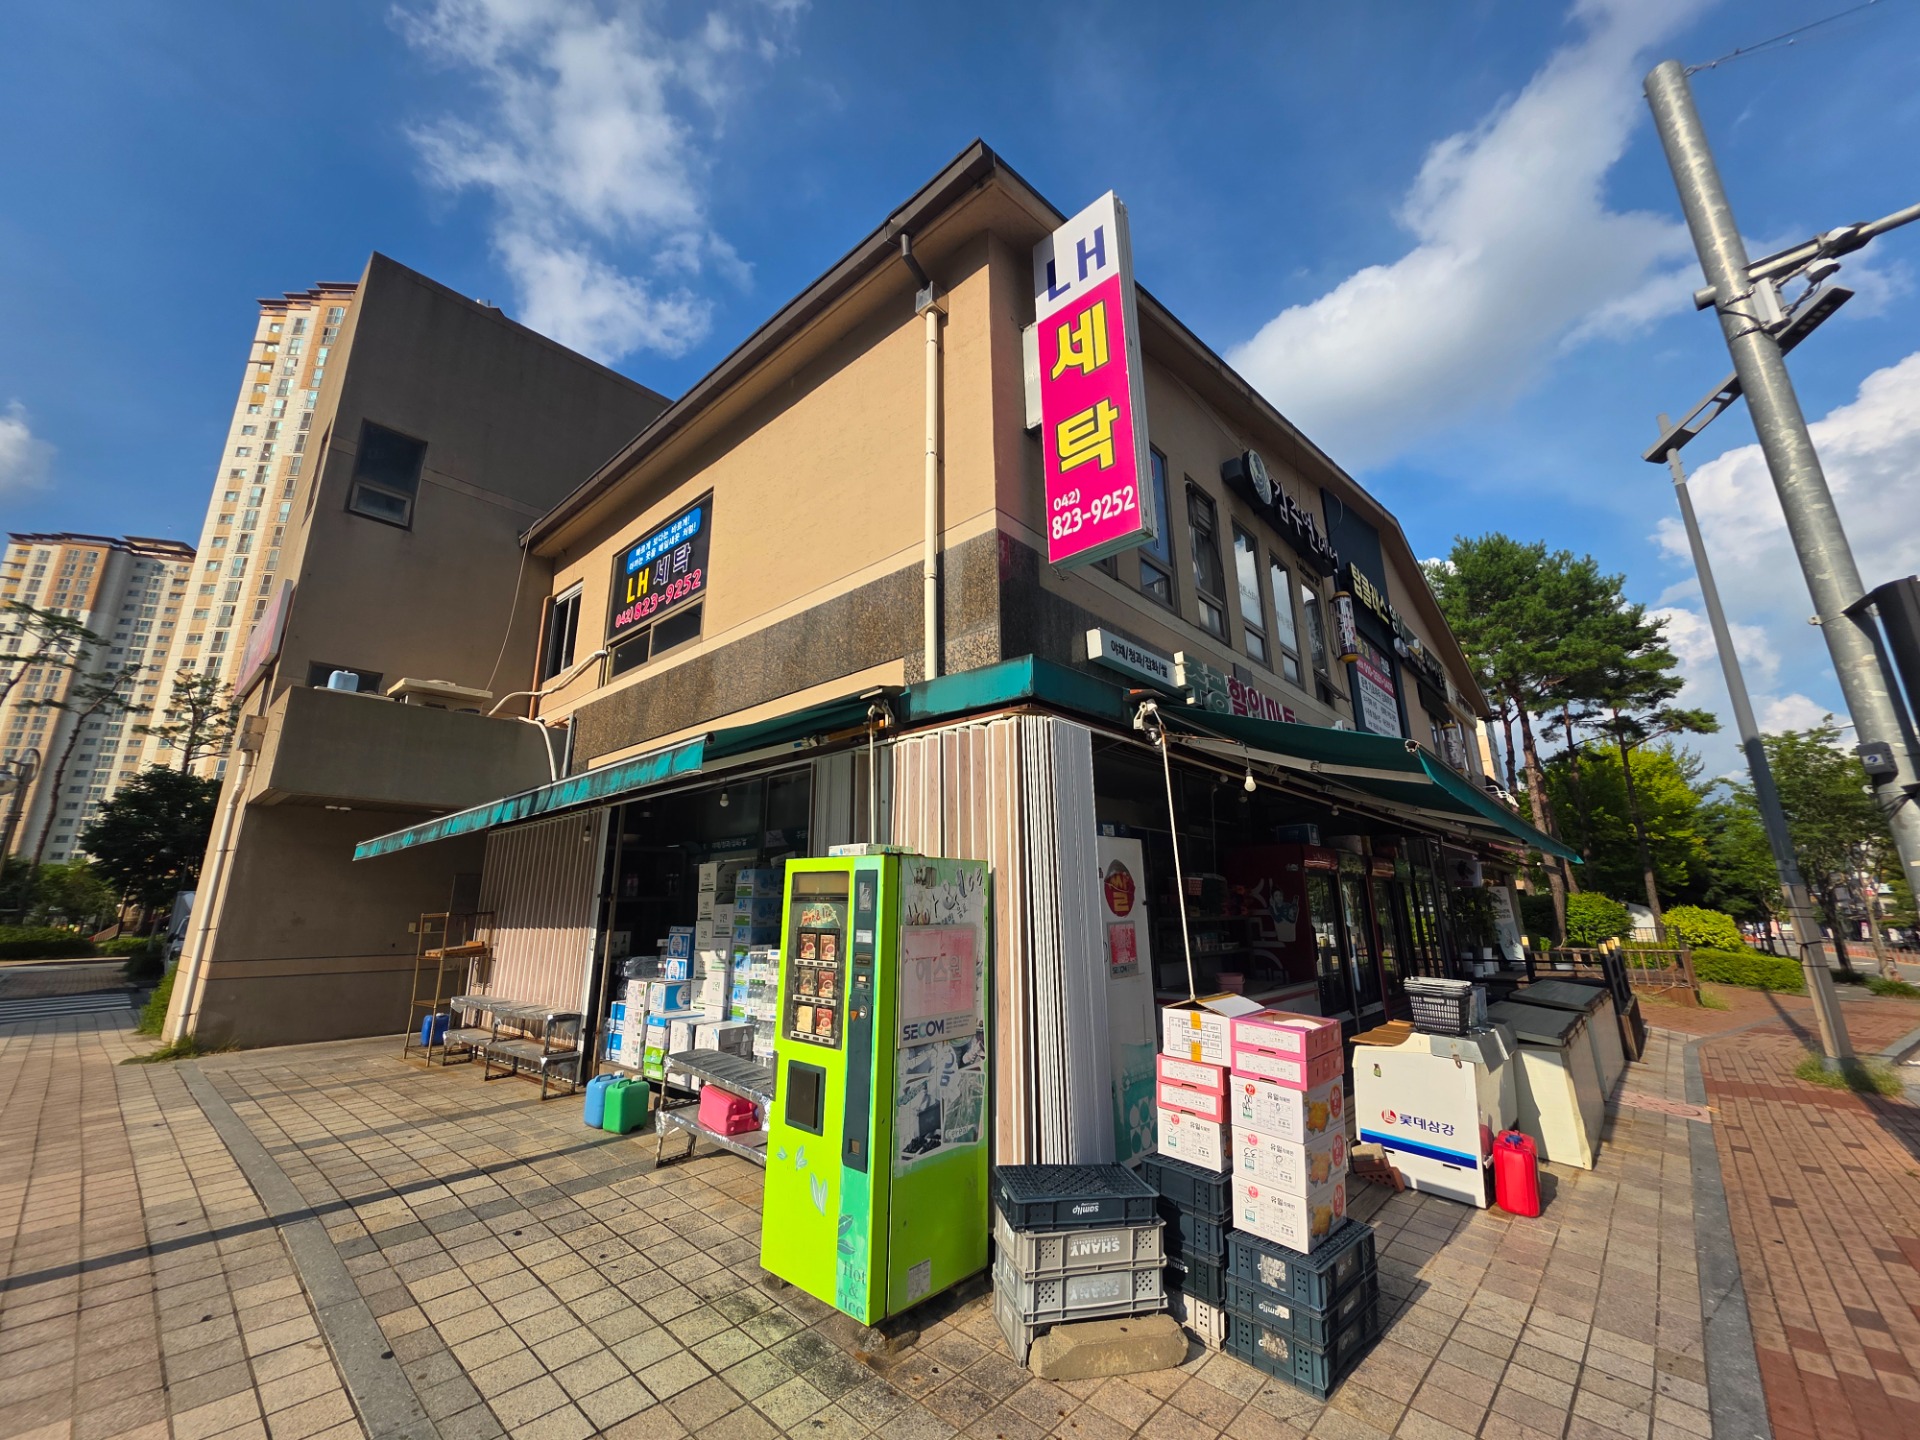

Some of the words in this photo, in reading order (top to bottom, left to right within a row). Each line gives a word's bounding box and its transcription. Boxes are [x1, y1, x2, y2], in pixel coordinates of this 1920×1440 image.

[1046, 225, 1107, 302] LH
[1050, 299, 1120, 474] 세탁
[1051, 485, 1135, 540] 823-9252
[1053, 487, 1081, 511] 042)
[626, 567, 650, 603] LH
[653, 542, 692, 586] 세탁
[634, 568, 702, 621] 823-9252
[1110, 639, 1169, 679] 야채/청과/잡화/쌀
[915, 956, 962, 985] 에스원
[902, 1018, 945, 1041] SECOM
[1399, 1113, 1456, 1136] 롯데삼강
[1070, 1240, 1120, 1257] SHANY
[848, 1282, 859, 1299] &
